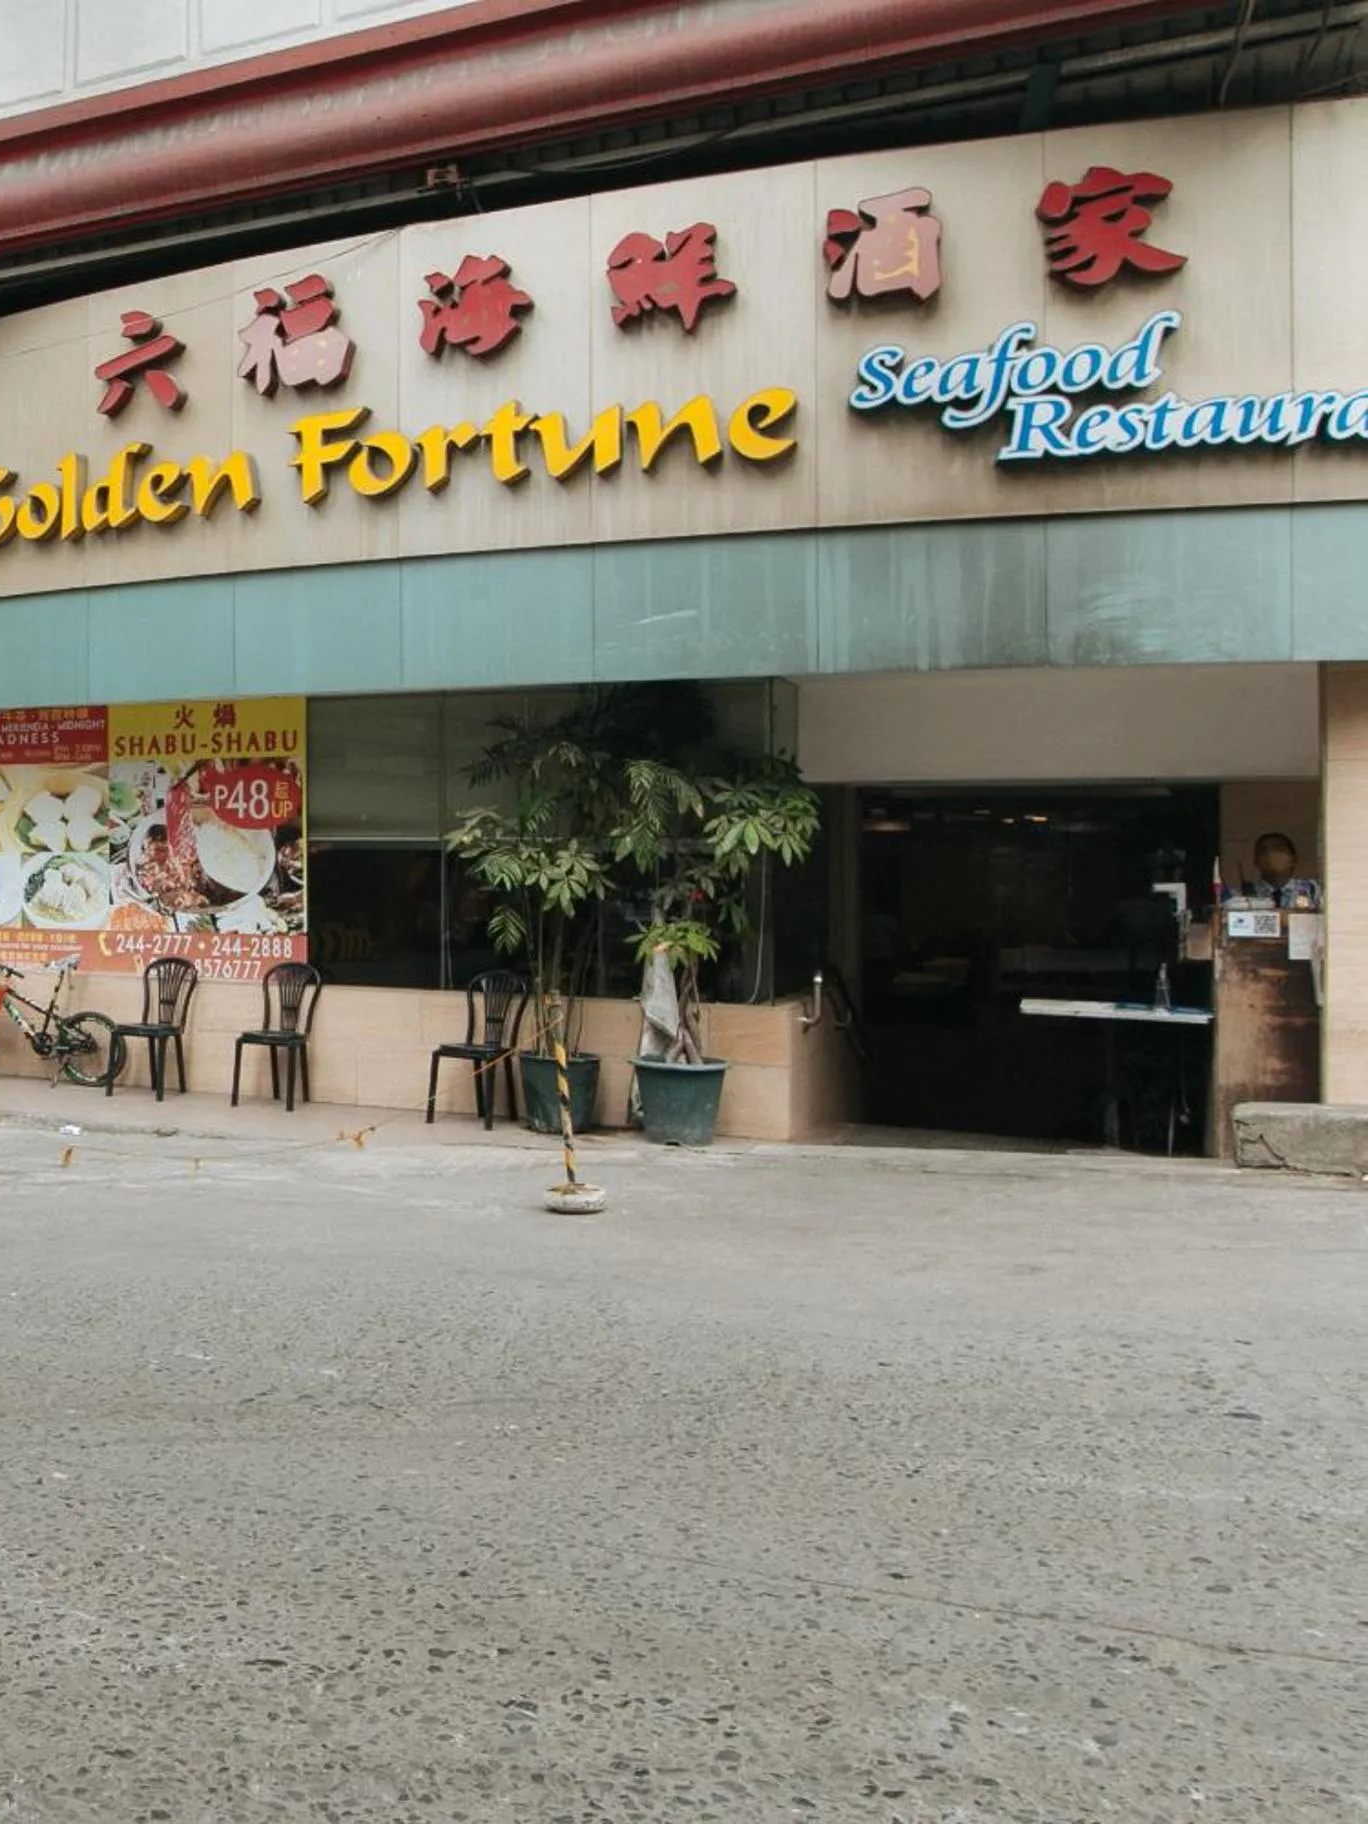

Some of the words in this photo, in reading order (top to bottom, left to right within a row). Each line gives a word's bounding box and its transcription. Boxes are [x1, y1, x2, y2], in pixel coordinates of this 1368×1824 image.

[848, 309, 1182, 430] Seafood
[288, 386, 800, 507] Fortune
[114, 728, 299, 758] SHABU-SHABU
[115, 933, 193, 955] 244-2777
[211, 935, 293, 958] 244-2888
